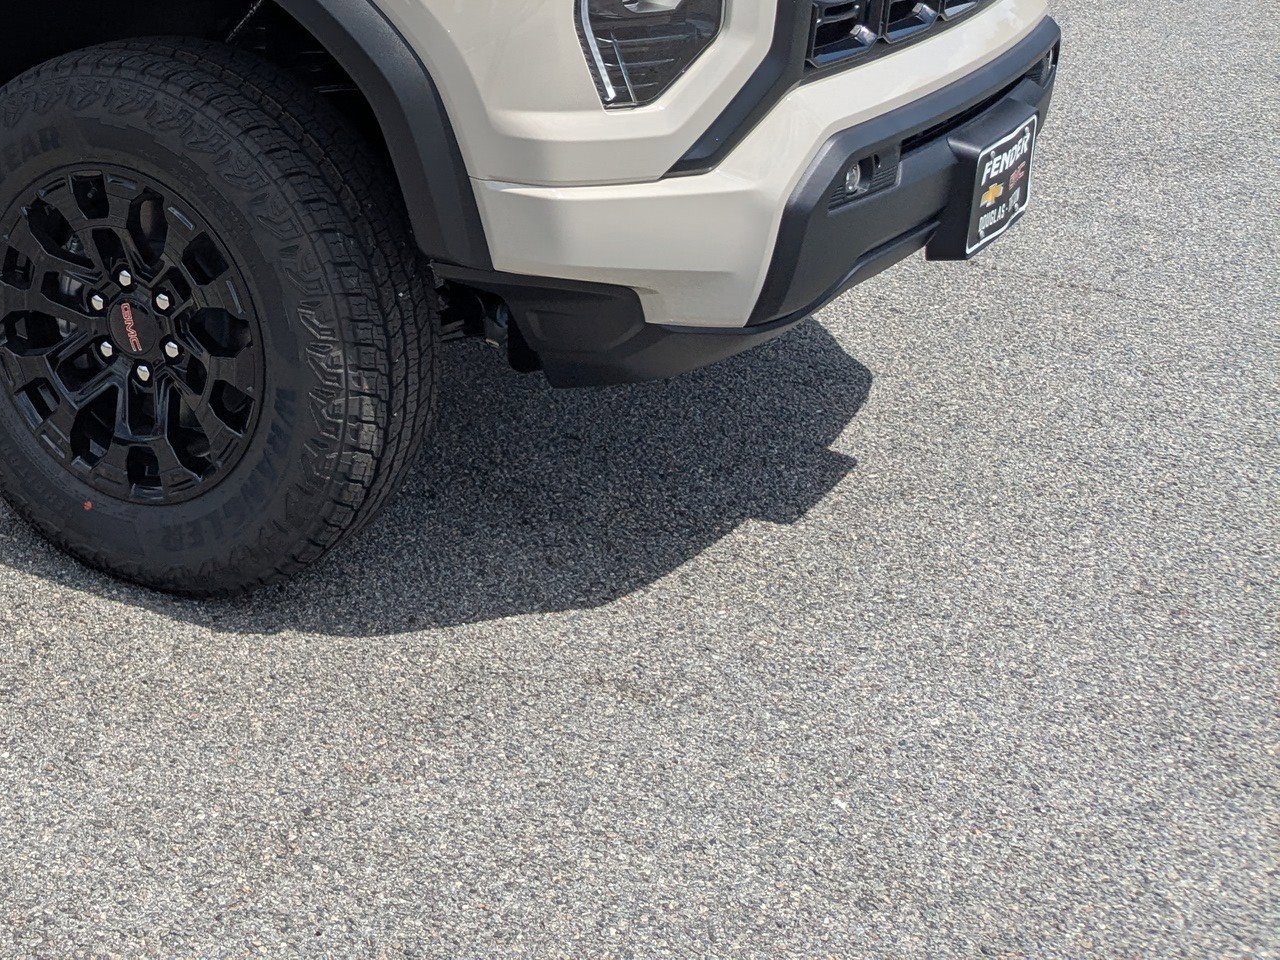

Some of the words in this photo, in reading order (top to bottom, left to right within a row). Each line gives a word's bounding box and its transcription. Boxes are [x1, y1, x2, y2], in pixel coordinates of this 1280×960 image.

[981, 133, 1030, 187] FENDER
[979, 203, 1006, 232] DOUGLAS
[120, 302, 142, 352] GMC
